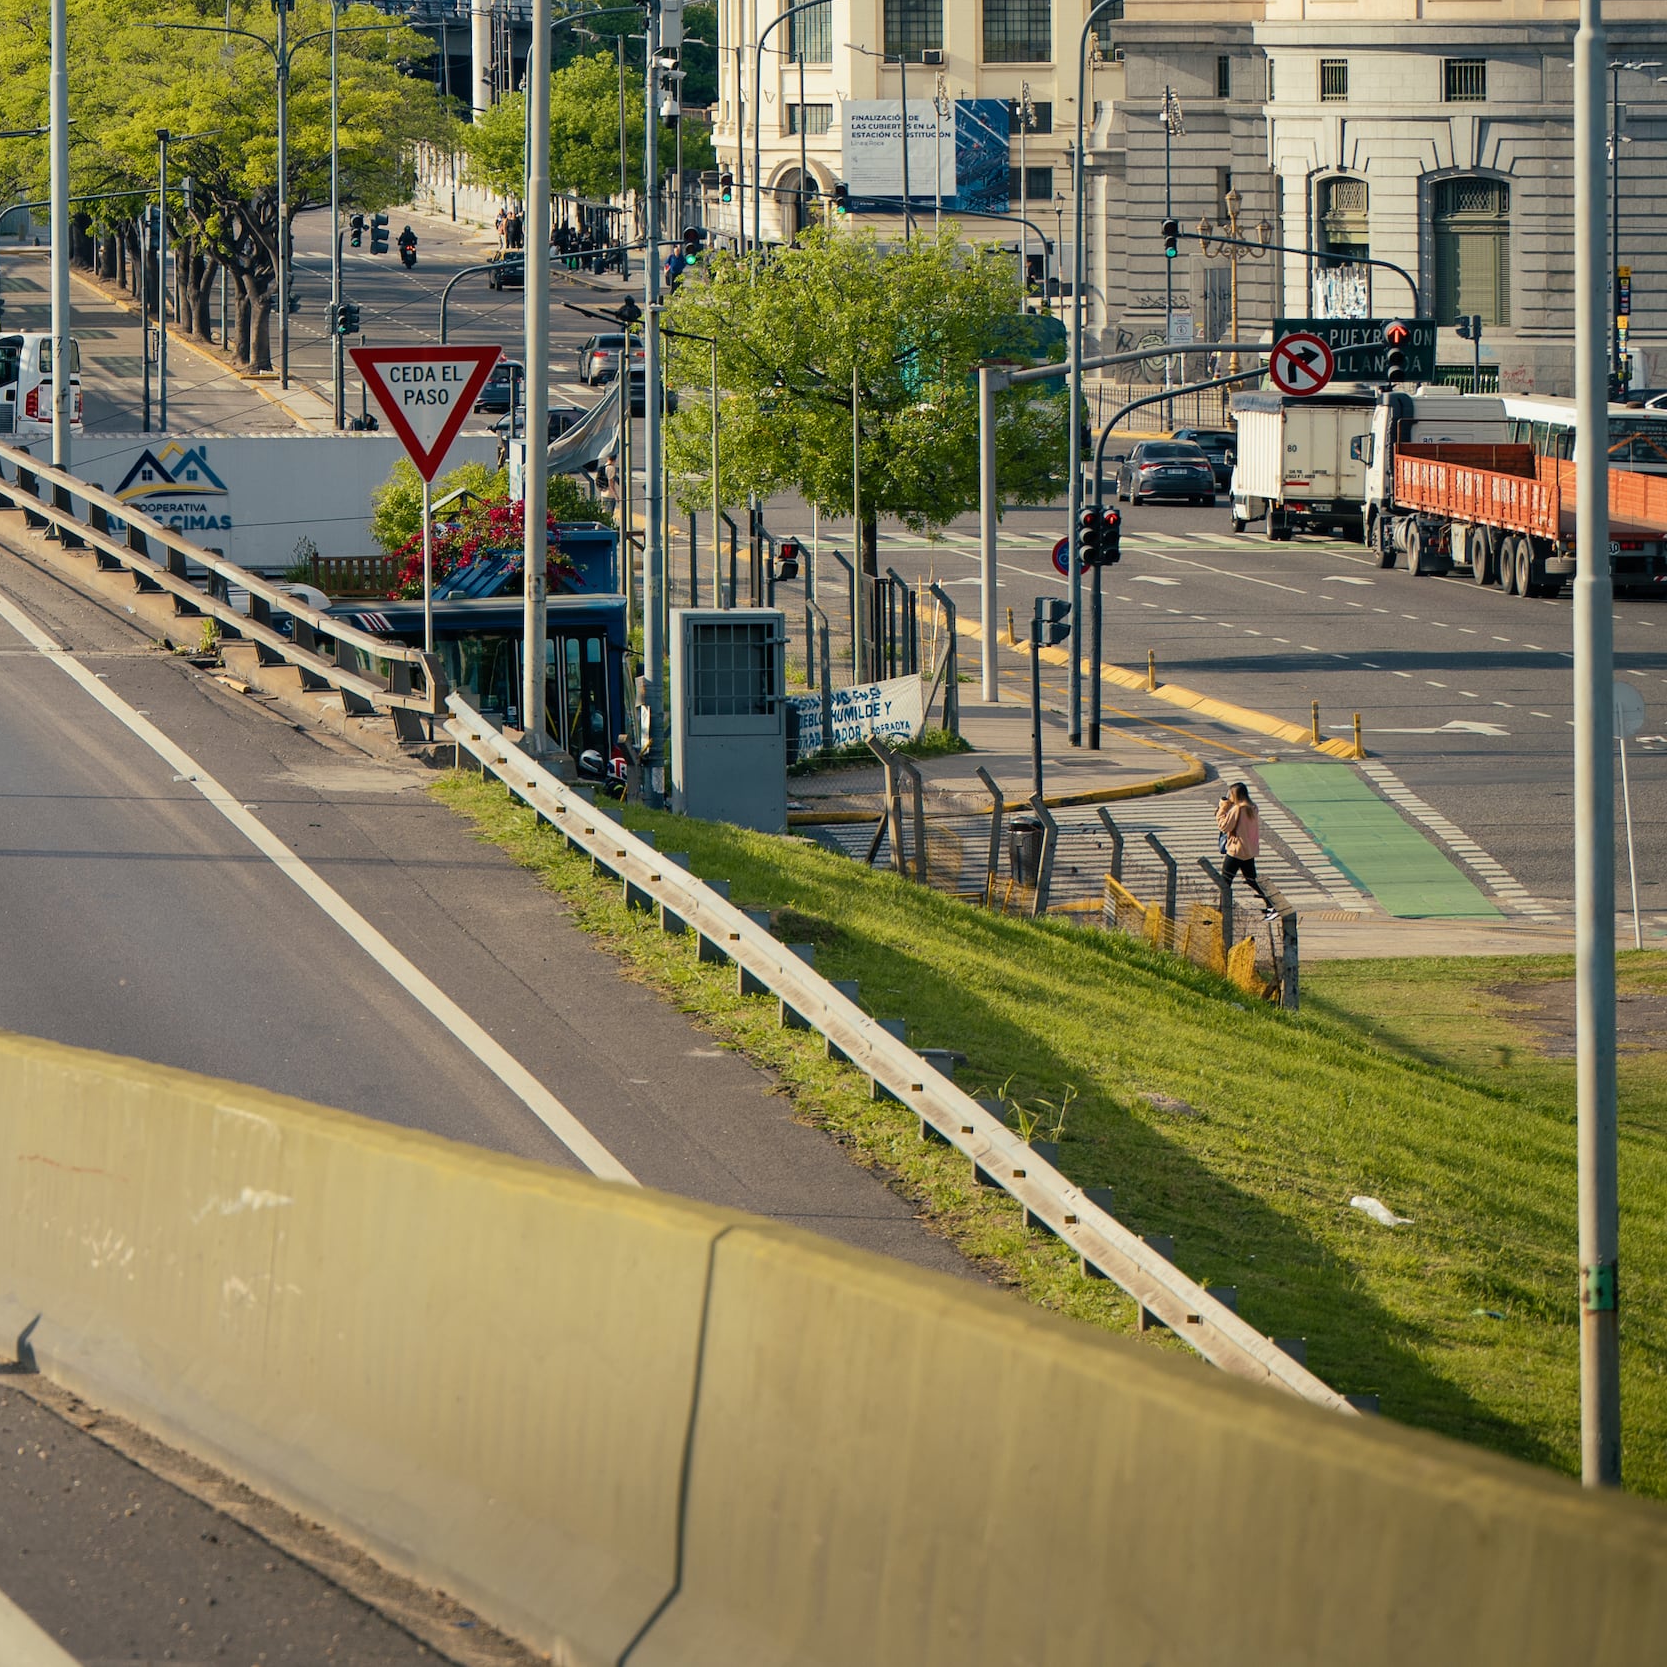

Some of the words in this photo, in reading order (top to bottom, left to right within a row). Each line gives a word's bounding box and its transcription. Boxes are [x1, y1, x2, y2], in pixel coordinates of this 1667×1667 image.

[851, 130, 891, 138] ESTACIÓN
[390, 366, 436, 382] CEDA
[442, 365, 463, 381] EL
[404, 388, 449, 405] PASO
[1287, 444, 1298, 453] 80
[139, 503, 207, 513] OOPERATIVA
[169, 514, 232, 531] CIMAS
[831, 701, 881, 723] HUMILDE
[884, 701, 892, 716] Y
